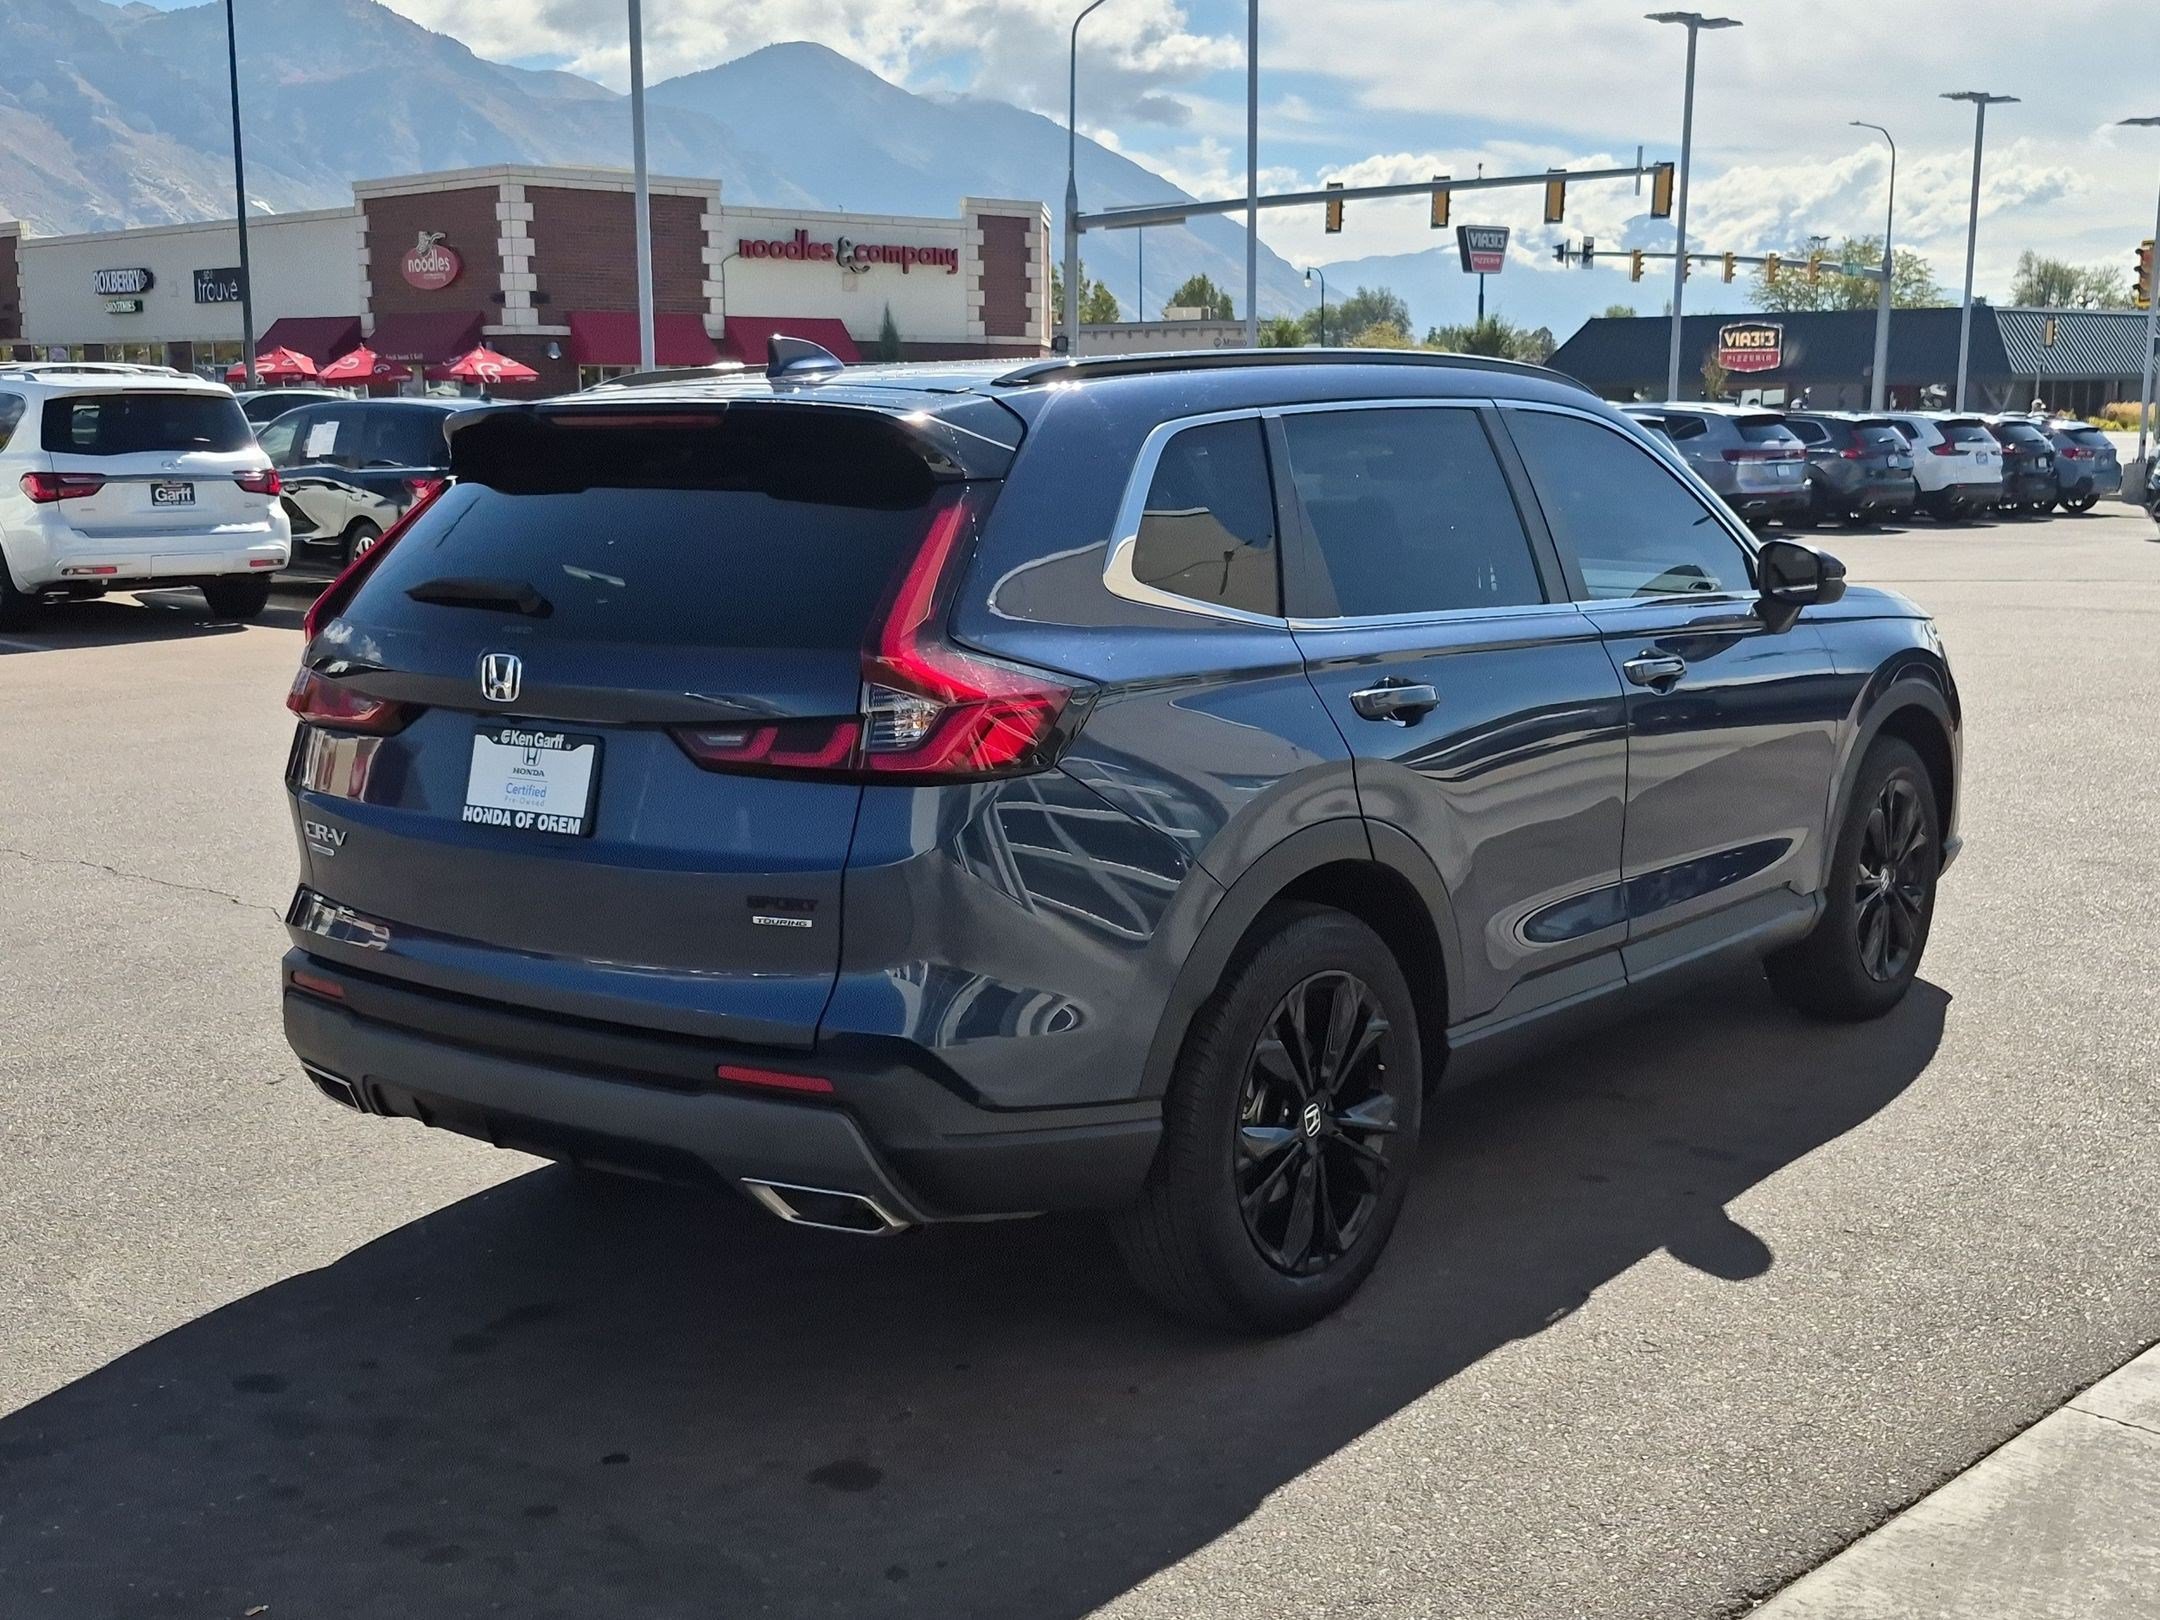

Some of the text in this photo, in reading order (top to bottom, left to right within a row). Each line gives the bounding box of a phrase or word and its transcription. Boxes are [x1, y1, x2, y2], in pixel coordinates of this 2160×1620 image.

[408, 249, 450, 273] noodles
[738, 228, 834, 261] noodles
[854, 244, 959, 275] company
[93, 269, 141, 294] ROXBERRY
[155, 486, 192, 501] Garff
[510, 729, 565, 750] Ken Garff
[512, 767, 545, 777] HONDA
[505, 782, 547, 798] Certified
[462, 805, 581, 836] HONDA OF OREM
[305, 820, 347, 847] CR-V
[756, 918, 807, 926] TOURING
